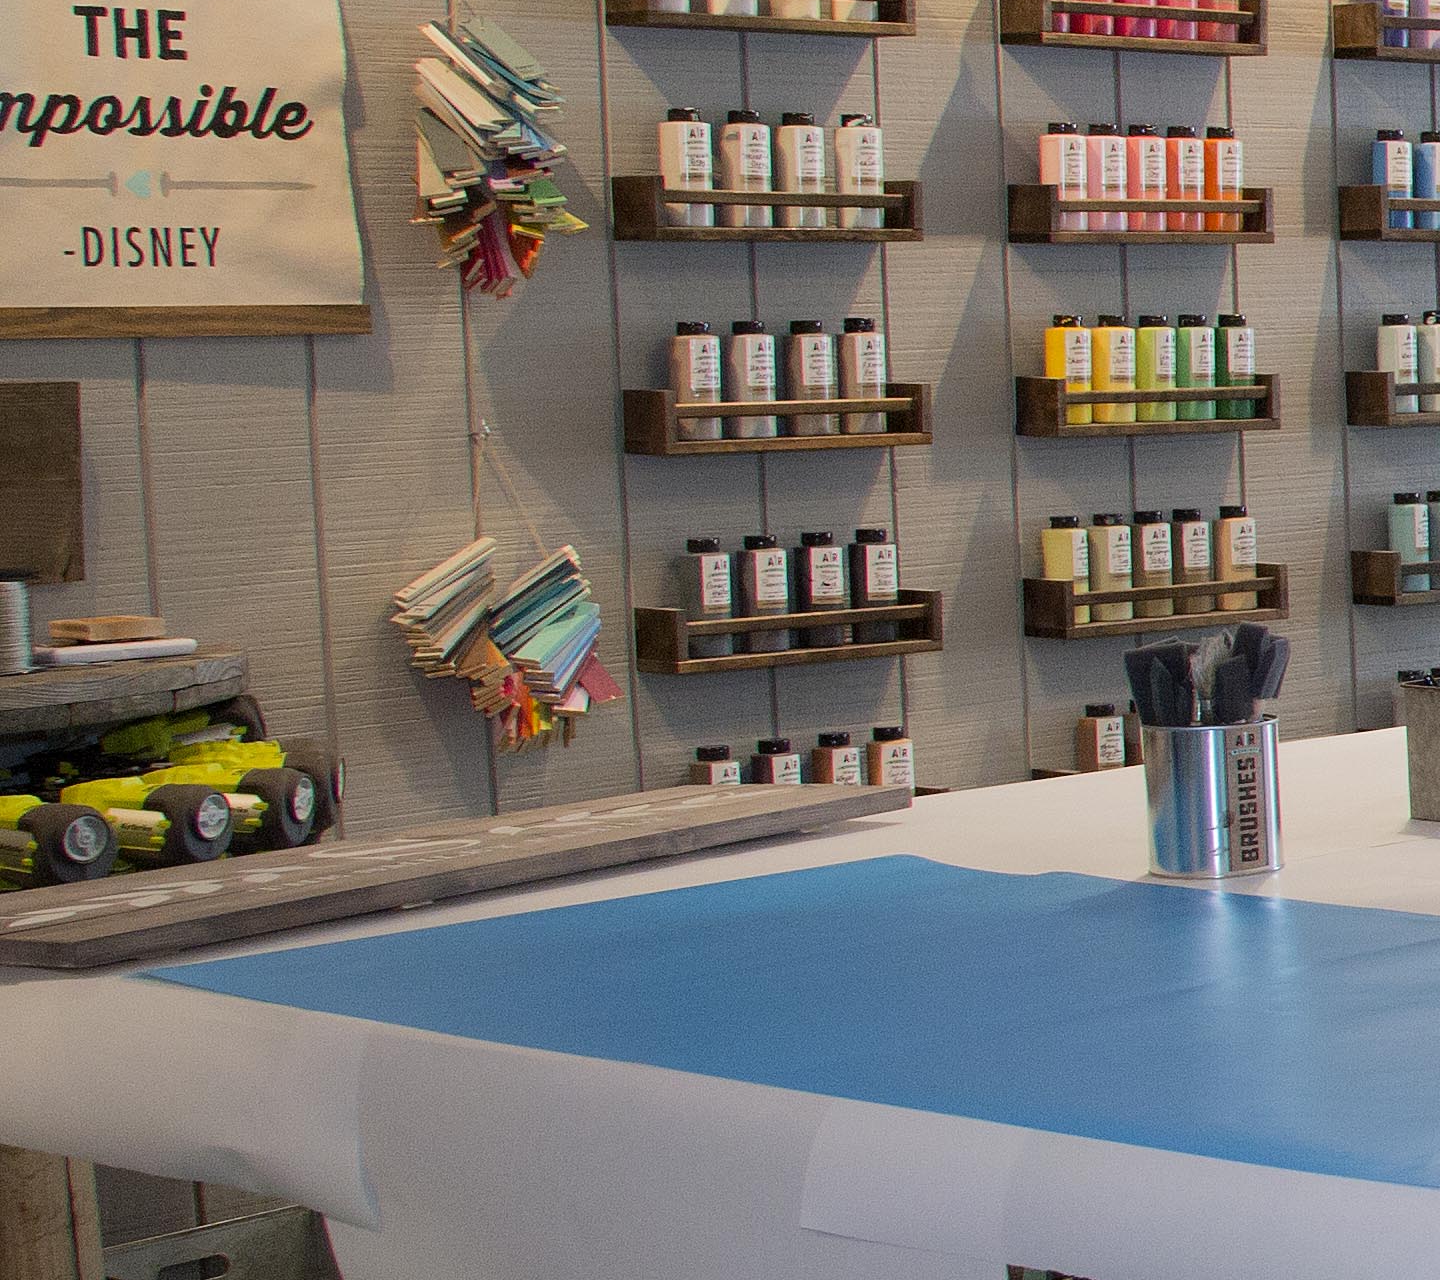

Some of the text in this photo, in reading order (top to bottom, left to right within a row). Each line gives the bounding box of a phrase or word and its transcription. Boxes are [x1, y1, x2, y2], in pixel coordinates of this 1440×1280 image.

[73, 5, 189, 62] THE
[0, 84, 315, 148] mpossible
[1236, 756, 1259, 863] BRUSHES
